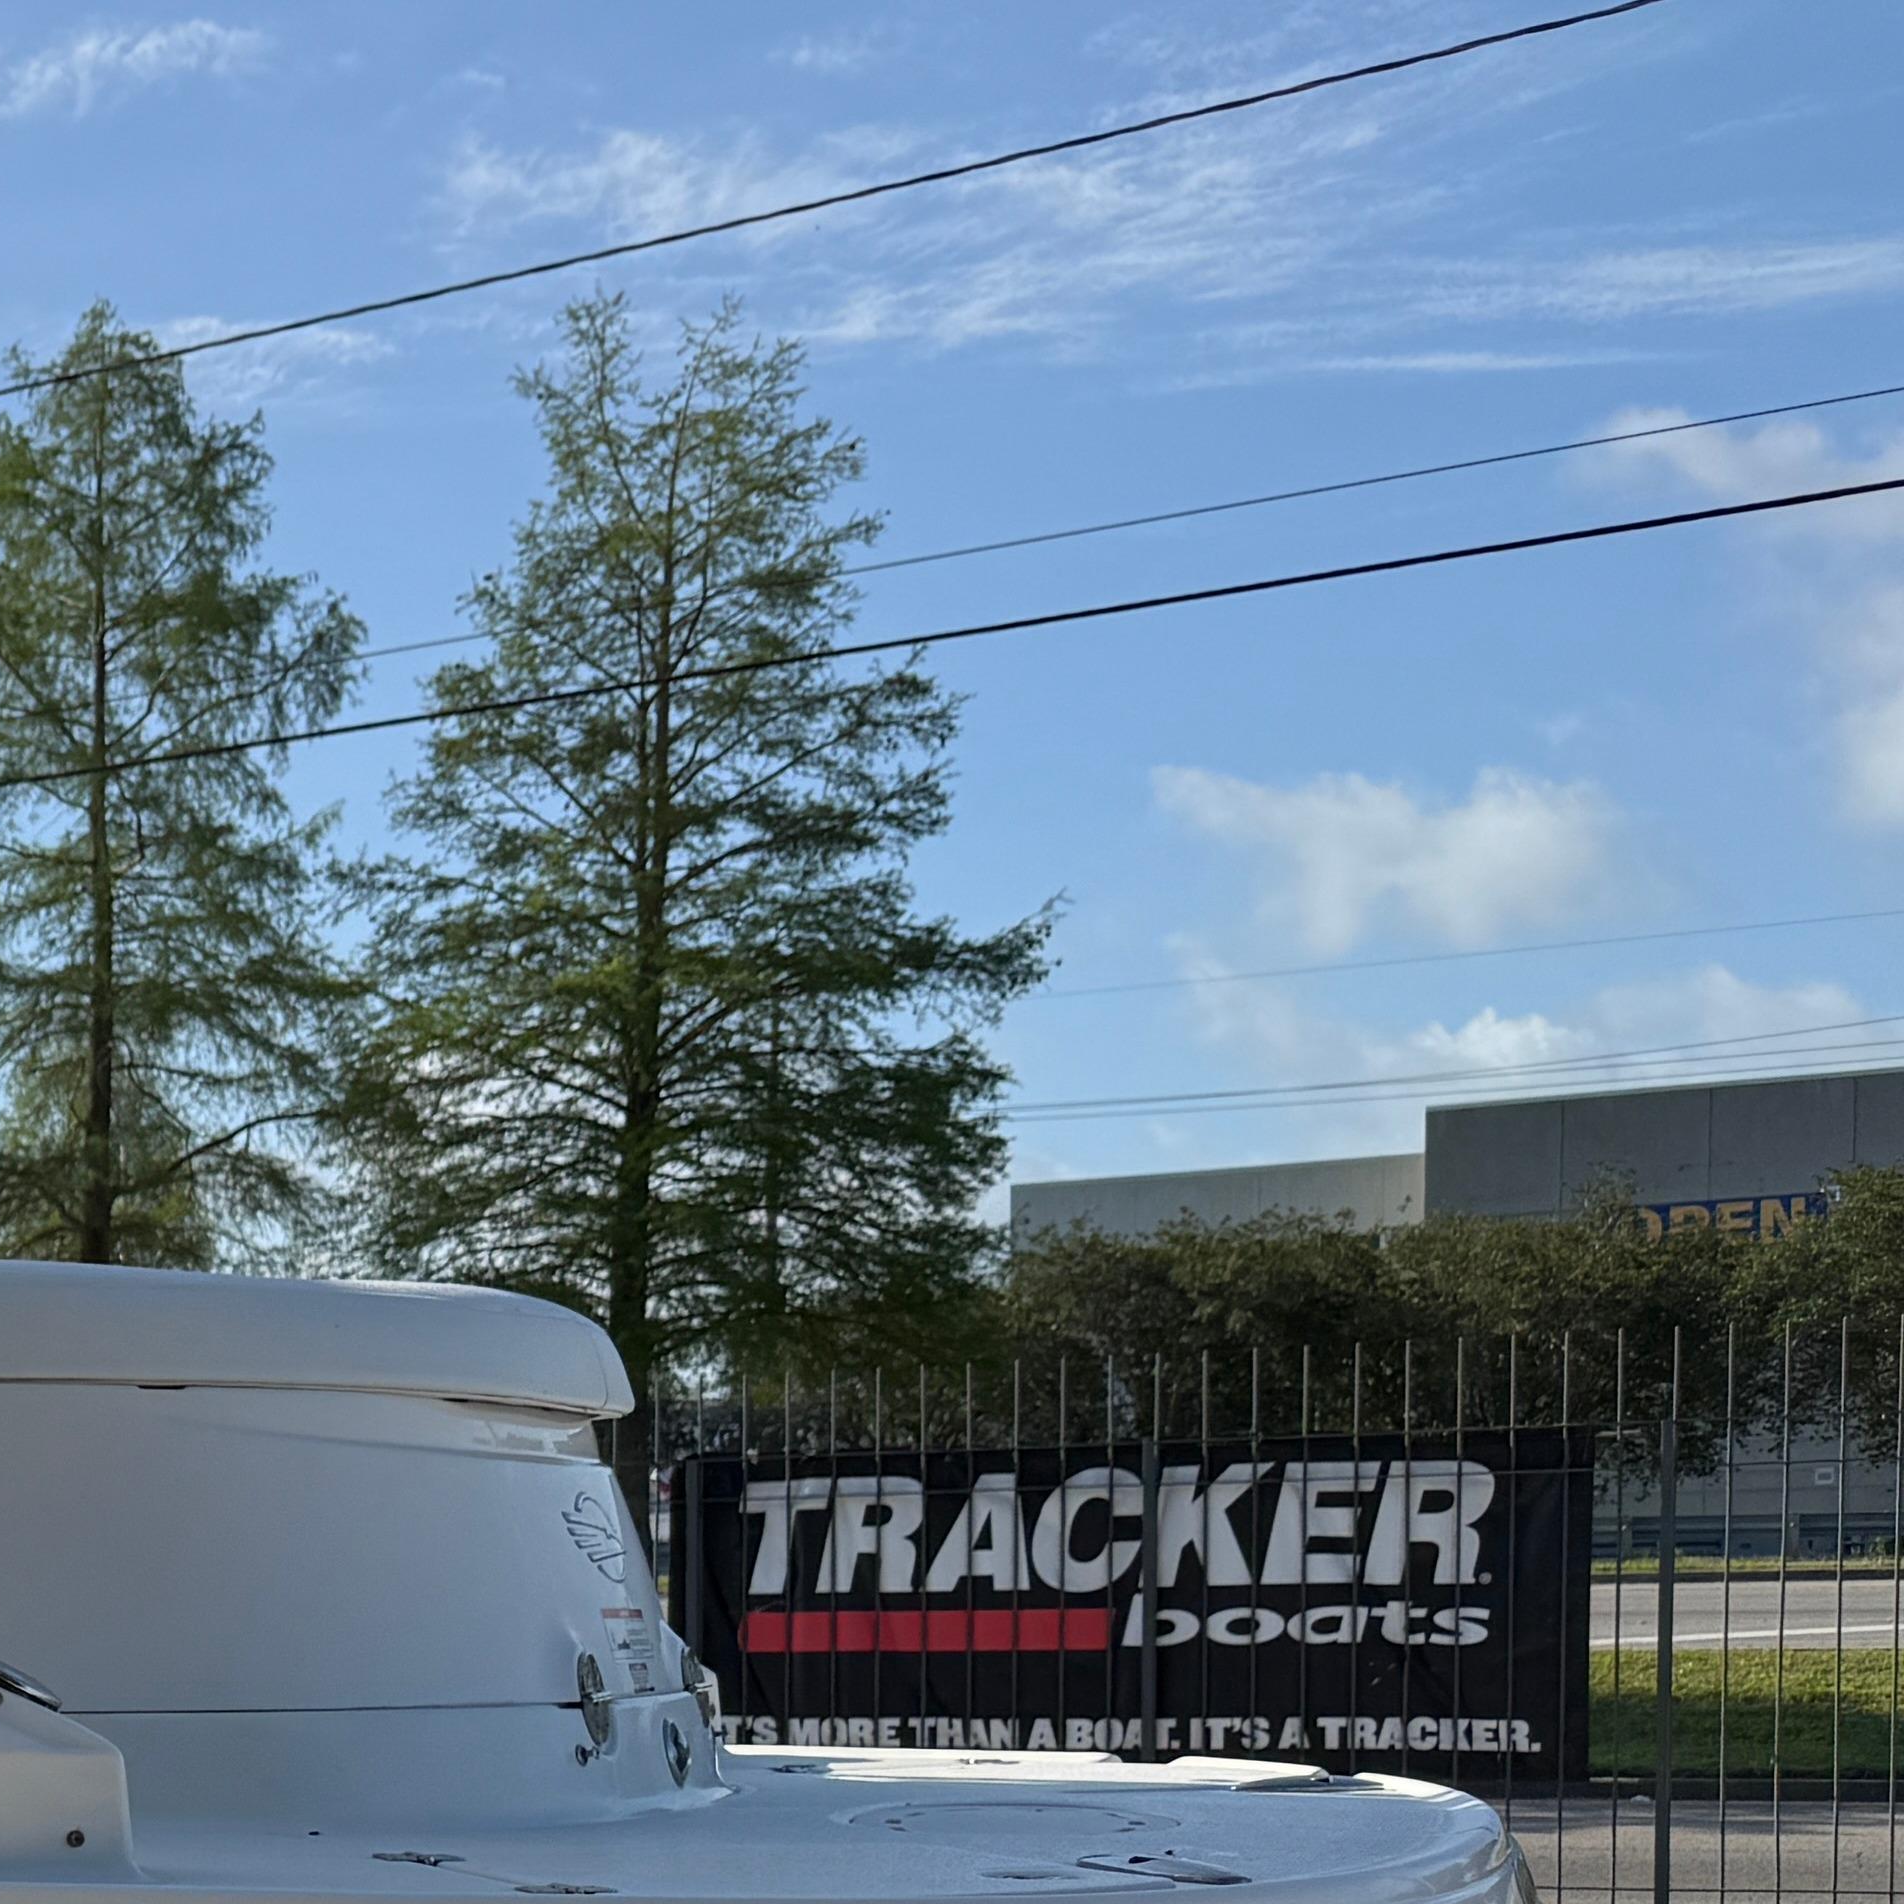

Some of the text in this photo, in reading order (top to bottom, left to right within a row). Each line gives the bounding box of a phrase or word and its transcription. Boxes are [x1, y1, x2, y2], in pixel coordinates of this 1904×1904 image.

[739, 1460, 1494, 1594] TRACKER
[1121, 1594, 1491, 1647] boats
[721, 1715, 1542, 1753] T'S MORE THAN A BOAT. IT'S A TRACKER.
